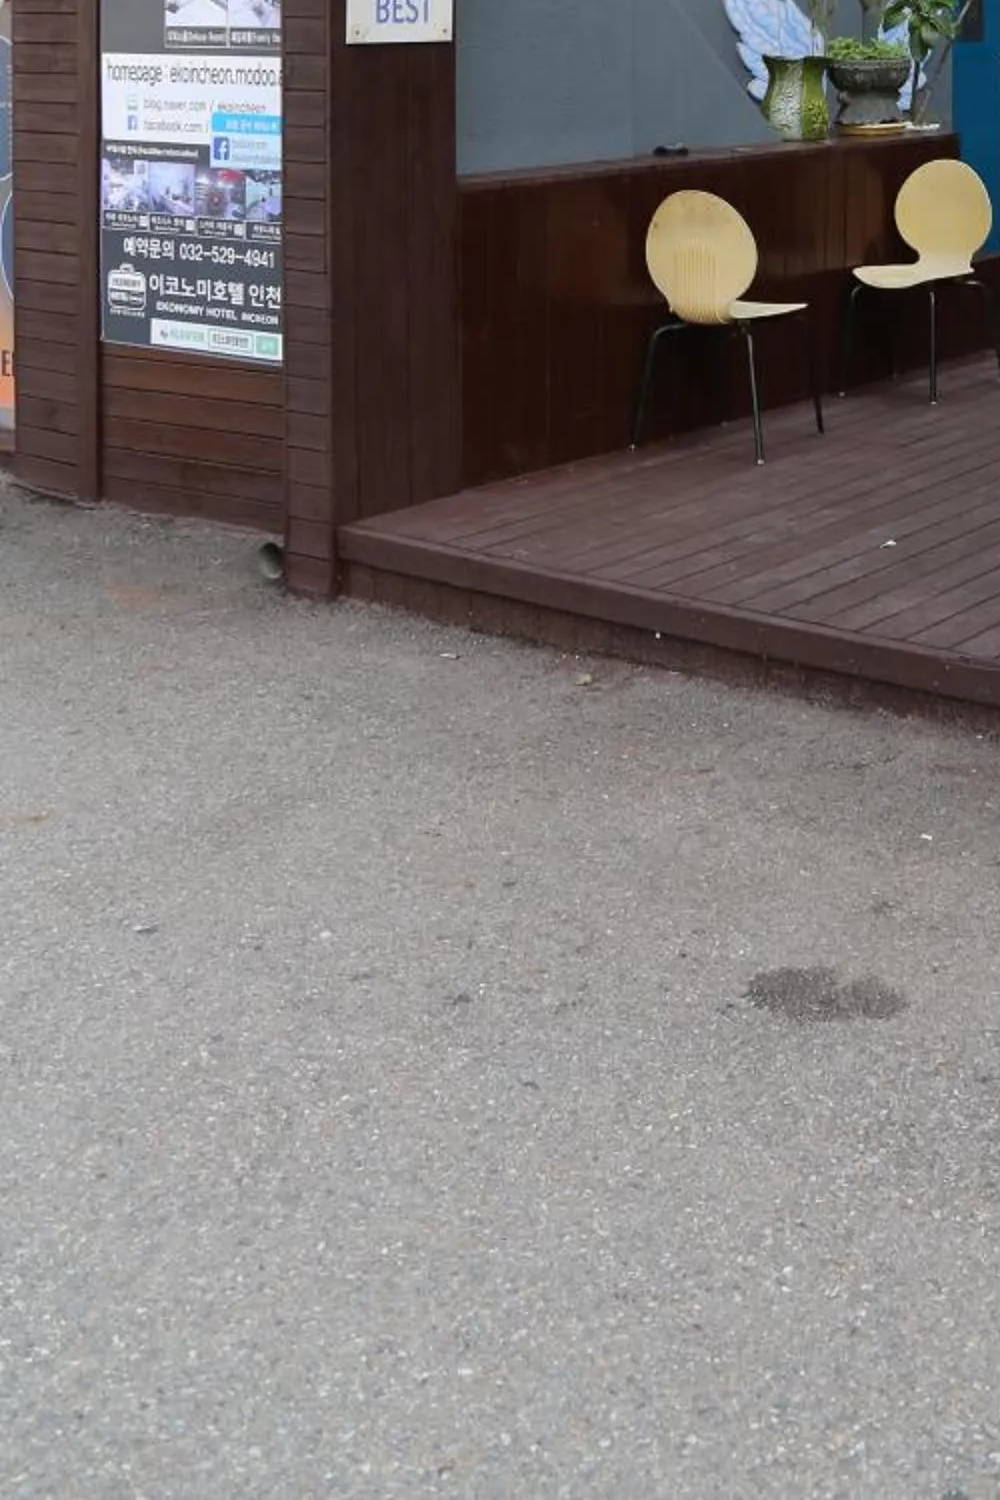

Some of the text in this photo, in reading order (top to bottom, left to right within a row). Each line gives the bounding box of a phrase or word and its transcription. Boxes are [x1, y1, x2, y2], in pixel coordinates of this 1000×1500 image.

[107, 59, 163, 86] homepage
[123, 236, 175, 261] 예약문의
[149, 273, 281, 310] 이코노미호텔 인천
